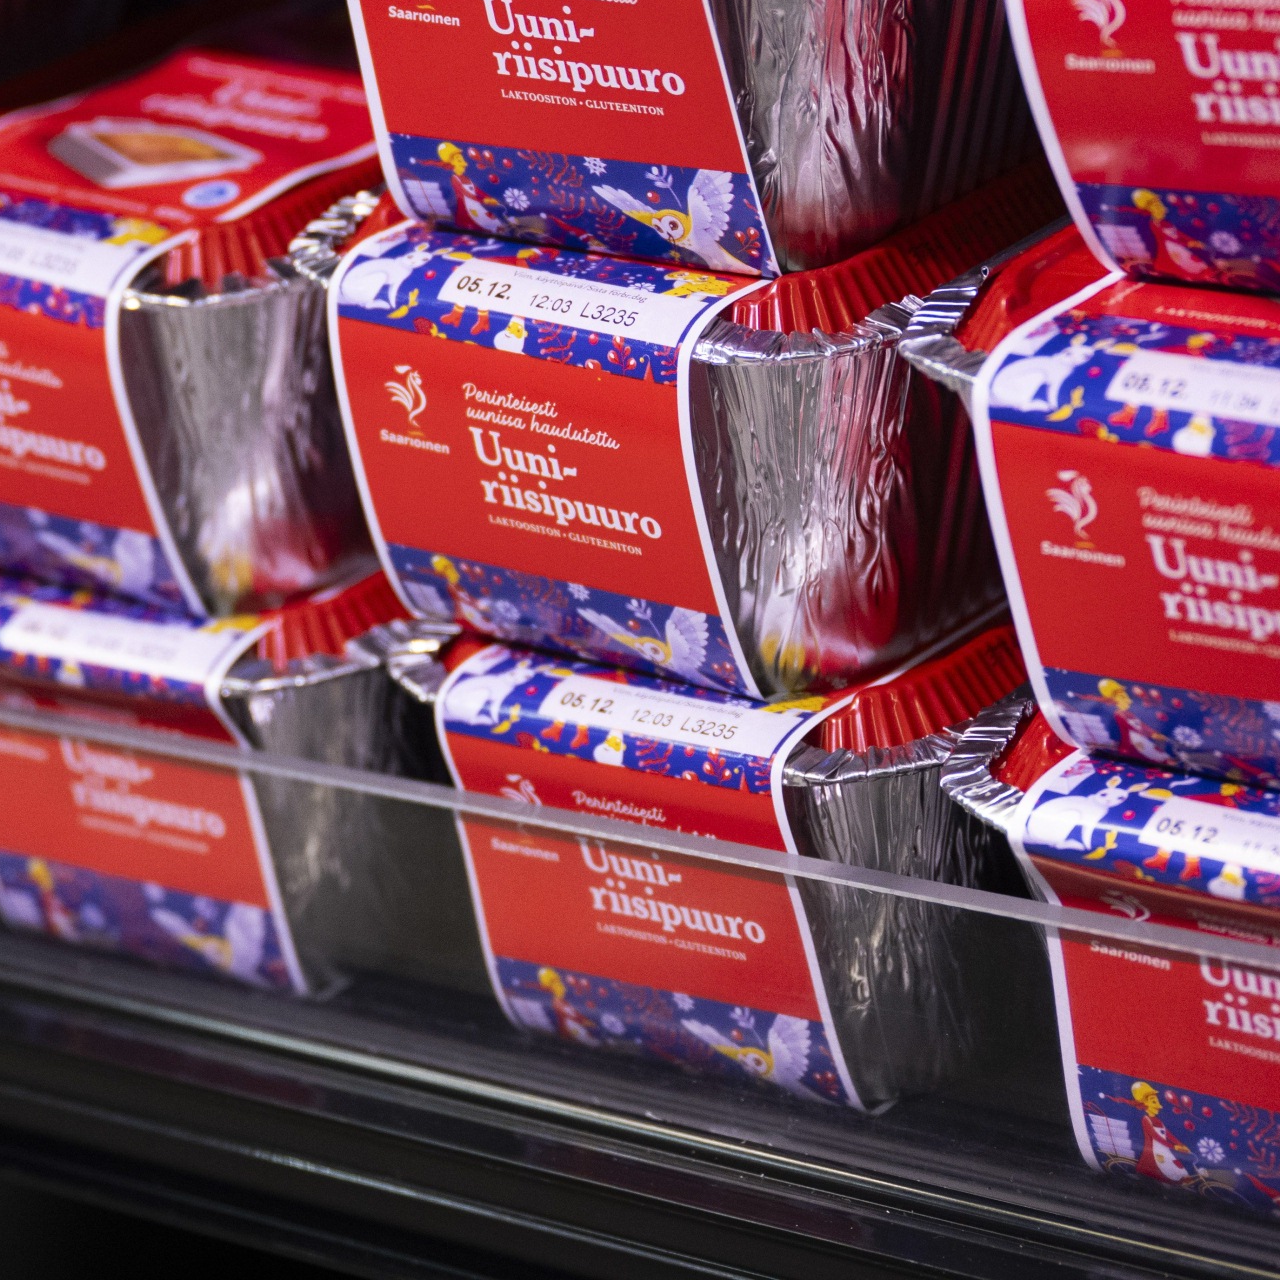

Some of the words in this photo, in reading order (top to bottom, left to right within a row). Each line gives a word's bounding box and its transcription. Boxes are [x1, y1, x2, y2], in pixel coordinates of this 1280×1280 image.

[388, 5, 461, 27] Saarioinen
[492, 39, 686, 96] riisipuuro
[501, 88, 577, 107] LAKTOOSITON
[585, 98, 665, 117] GLUTEENITON
[456, 275, 512, 300] 05.12.
[530, 293, 573, 313] 12:03
[580, 302, 639, 327] L3235
[462, 382, 559, 418] Perinteisesti
[380, 429, 450, 454] Saarioinen
[466, 407, 526, 430] uunissa
[530, 415, 621, 450] haudutettu
[469, 426, 577, 480] Uuni-
[481, 471, 663, 540] riisipuuro
[489, 514, 561, 538] LAKTOOSITON
[568, 532, 643, 556] GLUTEENITON
[560, 692, 614, 715] 05.12.
[631, 708, 674, 727] 12:03
[680, 716, 738, 740] L3235
[577, 836, 682, 886] Uuni-
[589, 877, 766, 944] riisipuuro
